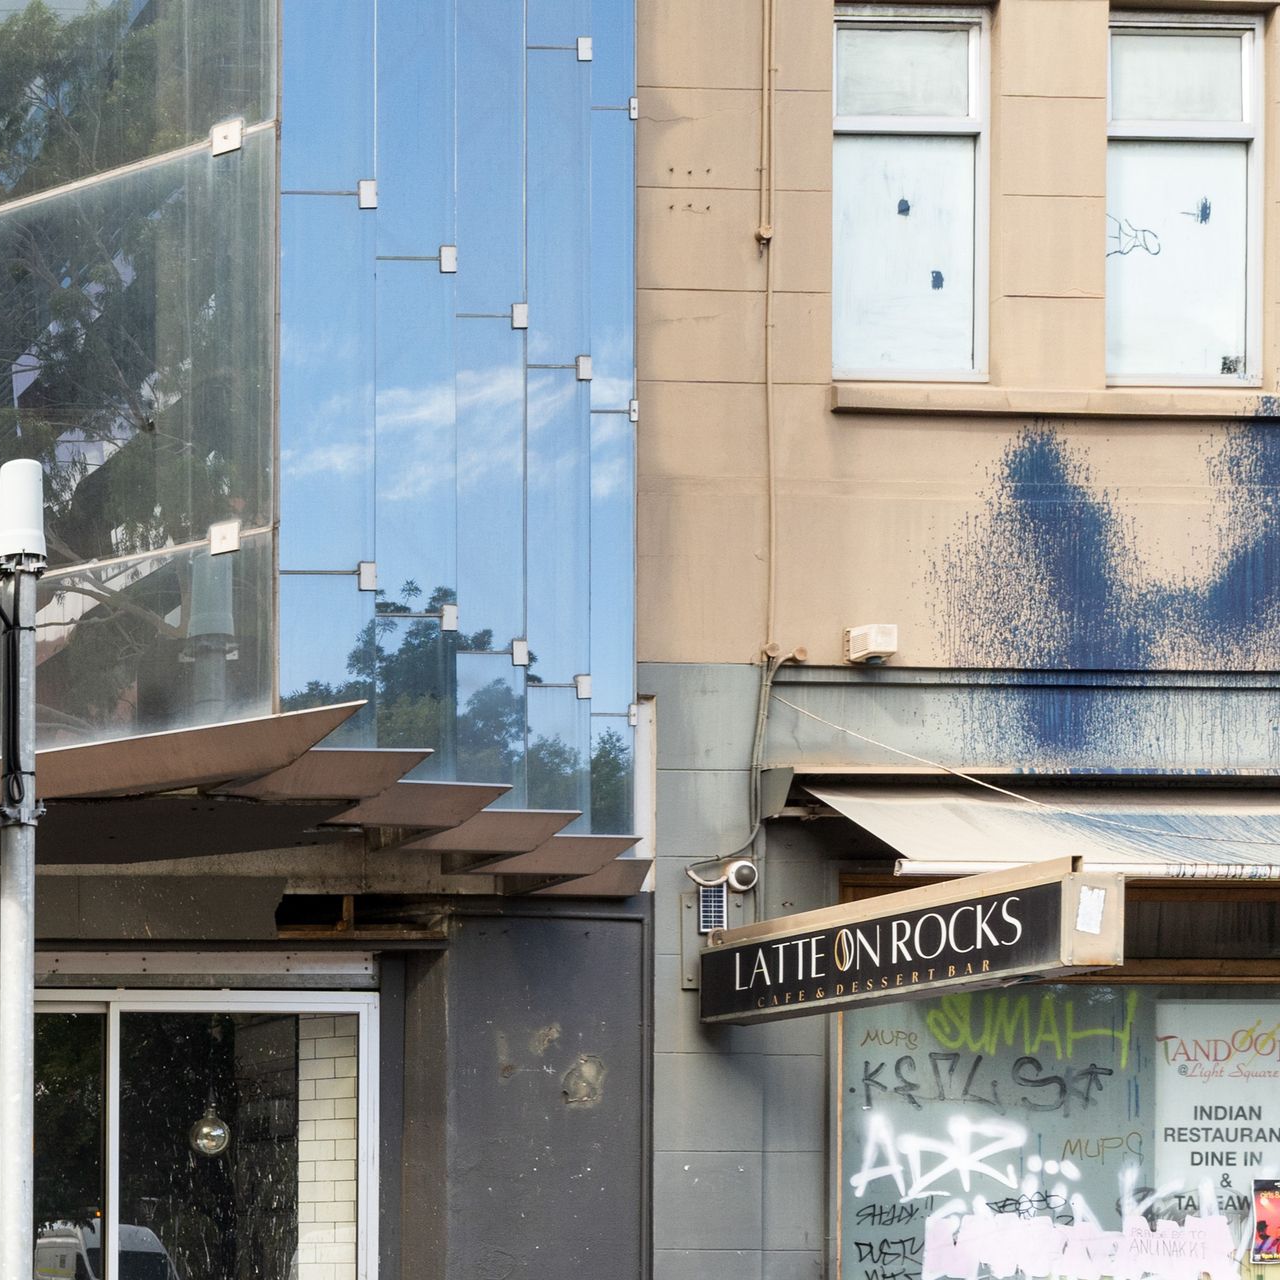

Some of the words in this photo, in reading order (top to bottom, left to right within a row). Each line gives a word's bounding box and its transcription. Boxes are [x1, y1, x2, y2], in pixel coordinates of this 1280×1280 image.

[735, 935, 826, 991] LATTE
[834, 925, 881, 972] ON
[892, 896, 1023, 964] ROCKS
[757, 989, 805, 1008] CAFE
[815, 987, 825, 998] &
[836, 968, 934, 995] DESSERT
[948, 959, 991, 977] BAR
[1156, 1030, 1280, 1066] TANDOO
[1193, 1105, 1262, 1121] INDIAN
[1163, 1127, 1280, 1142] RESTAURAN
[1190, 1151, 1237, 1167] DINE
[1244, 1151, 1263, 1167] IN
[1220, 1173, 1233, 1188] &
